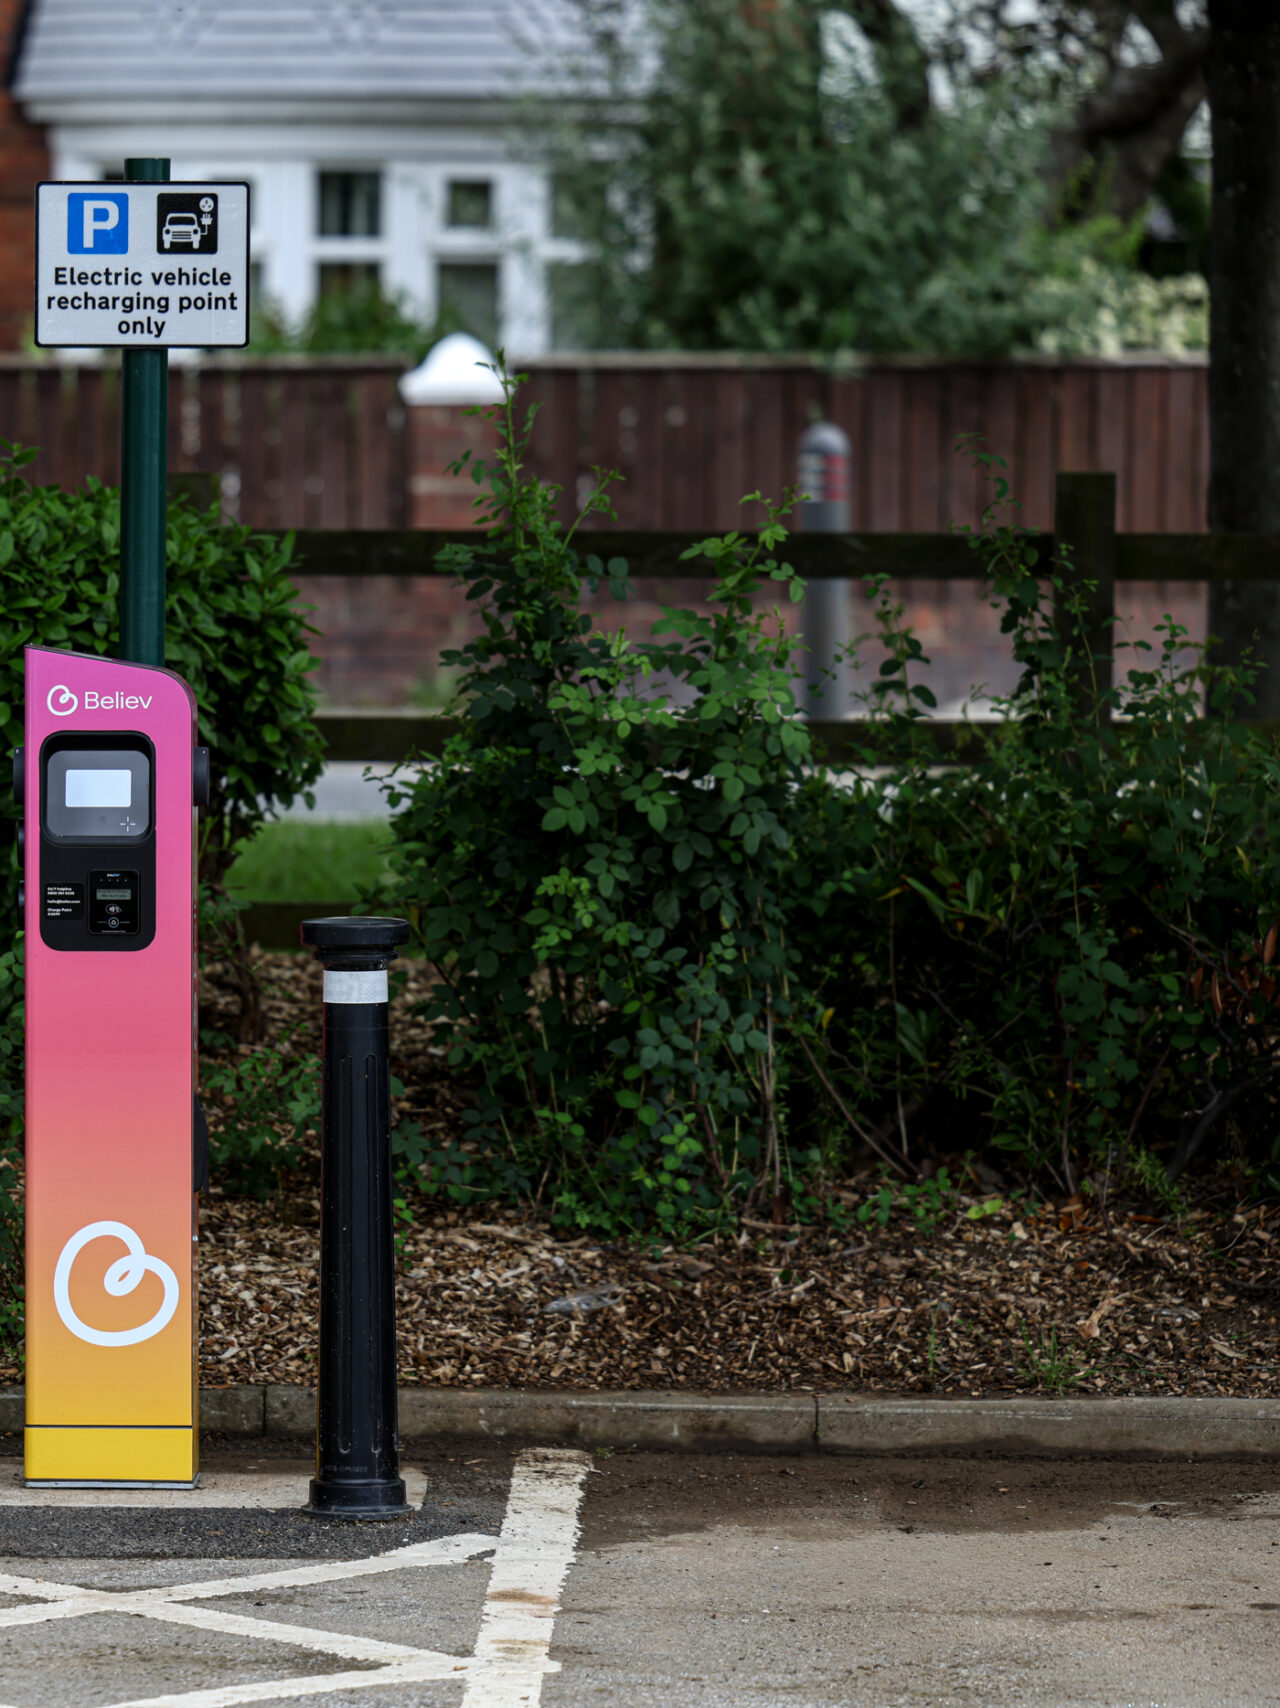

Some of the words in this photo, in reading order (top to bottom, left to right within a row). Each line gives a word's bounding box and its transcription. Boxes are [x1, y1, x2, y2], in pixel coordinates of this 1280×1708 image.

[83, 200, 120, 248] P
[54, 267, 143, 286] Electric
[151, 267, 232, 286] vehicle
[47, 292, 170, 313] recharging
[179, 292, 238, 313] point
[118, 316, 166, 338] only
[84, 691, 153, 710] Believ
